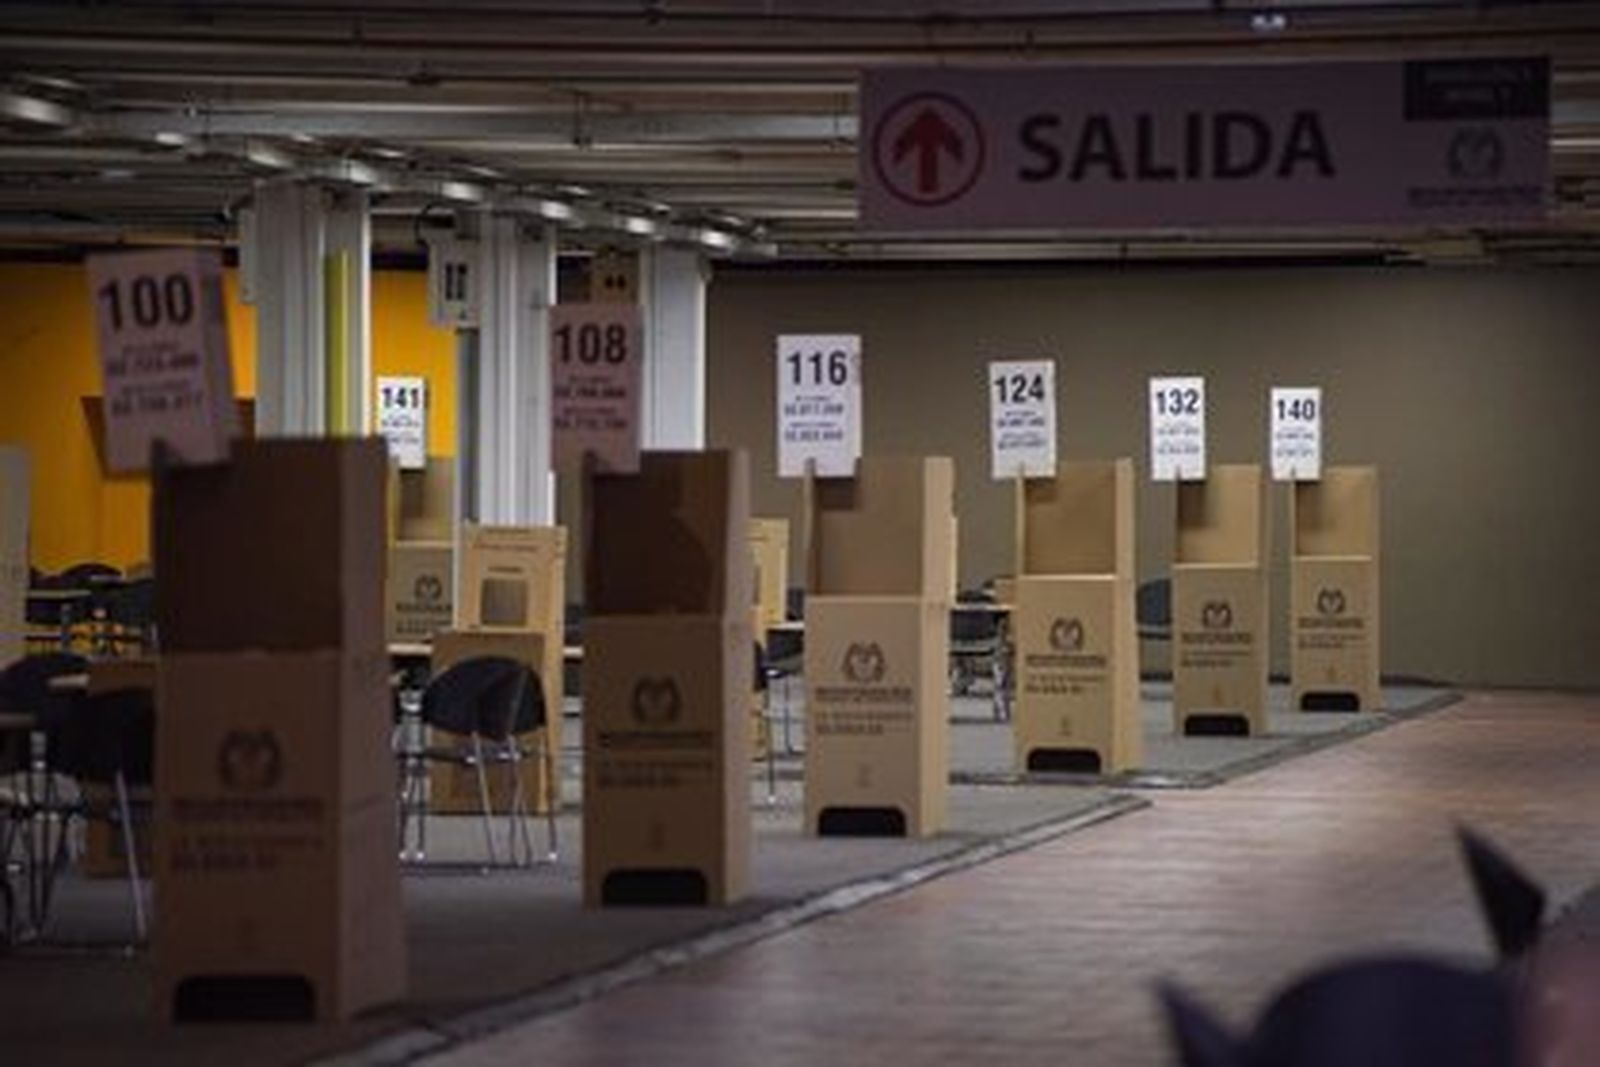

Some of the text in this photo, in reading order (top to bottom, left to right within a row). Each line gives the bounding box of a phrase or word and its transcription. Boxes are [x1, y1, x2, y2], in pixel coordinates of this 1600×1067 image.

[1017, 109, 1336, 184] SALIDA
[100, 273, 193, 331] 100
[554, 321, 627, 365] 108
[785, 350, 848, 386] 116
[381, 387, 420, 408] 141
[993, 373, 1045, 402] 124
[1156, 388, 1200, 415] 132
[1276, 398, 1316, 420] 140
